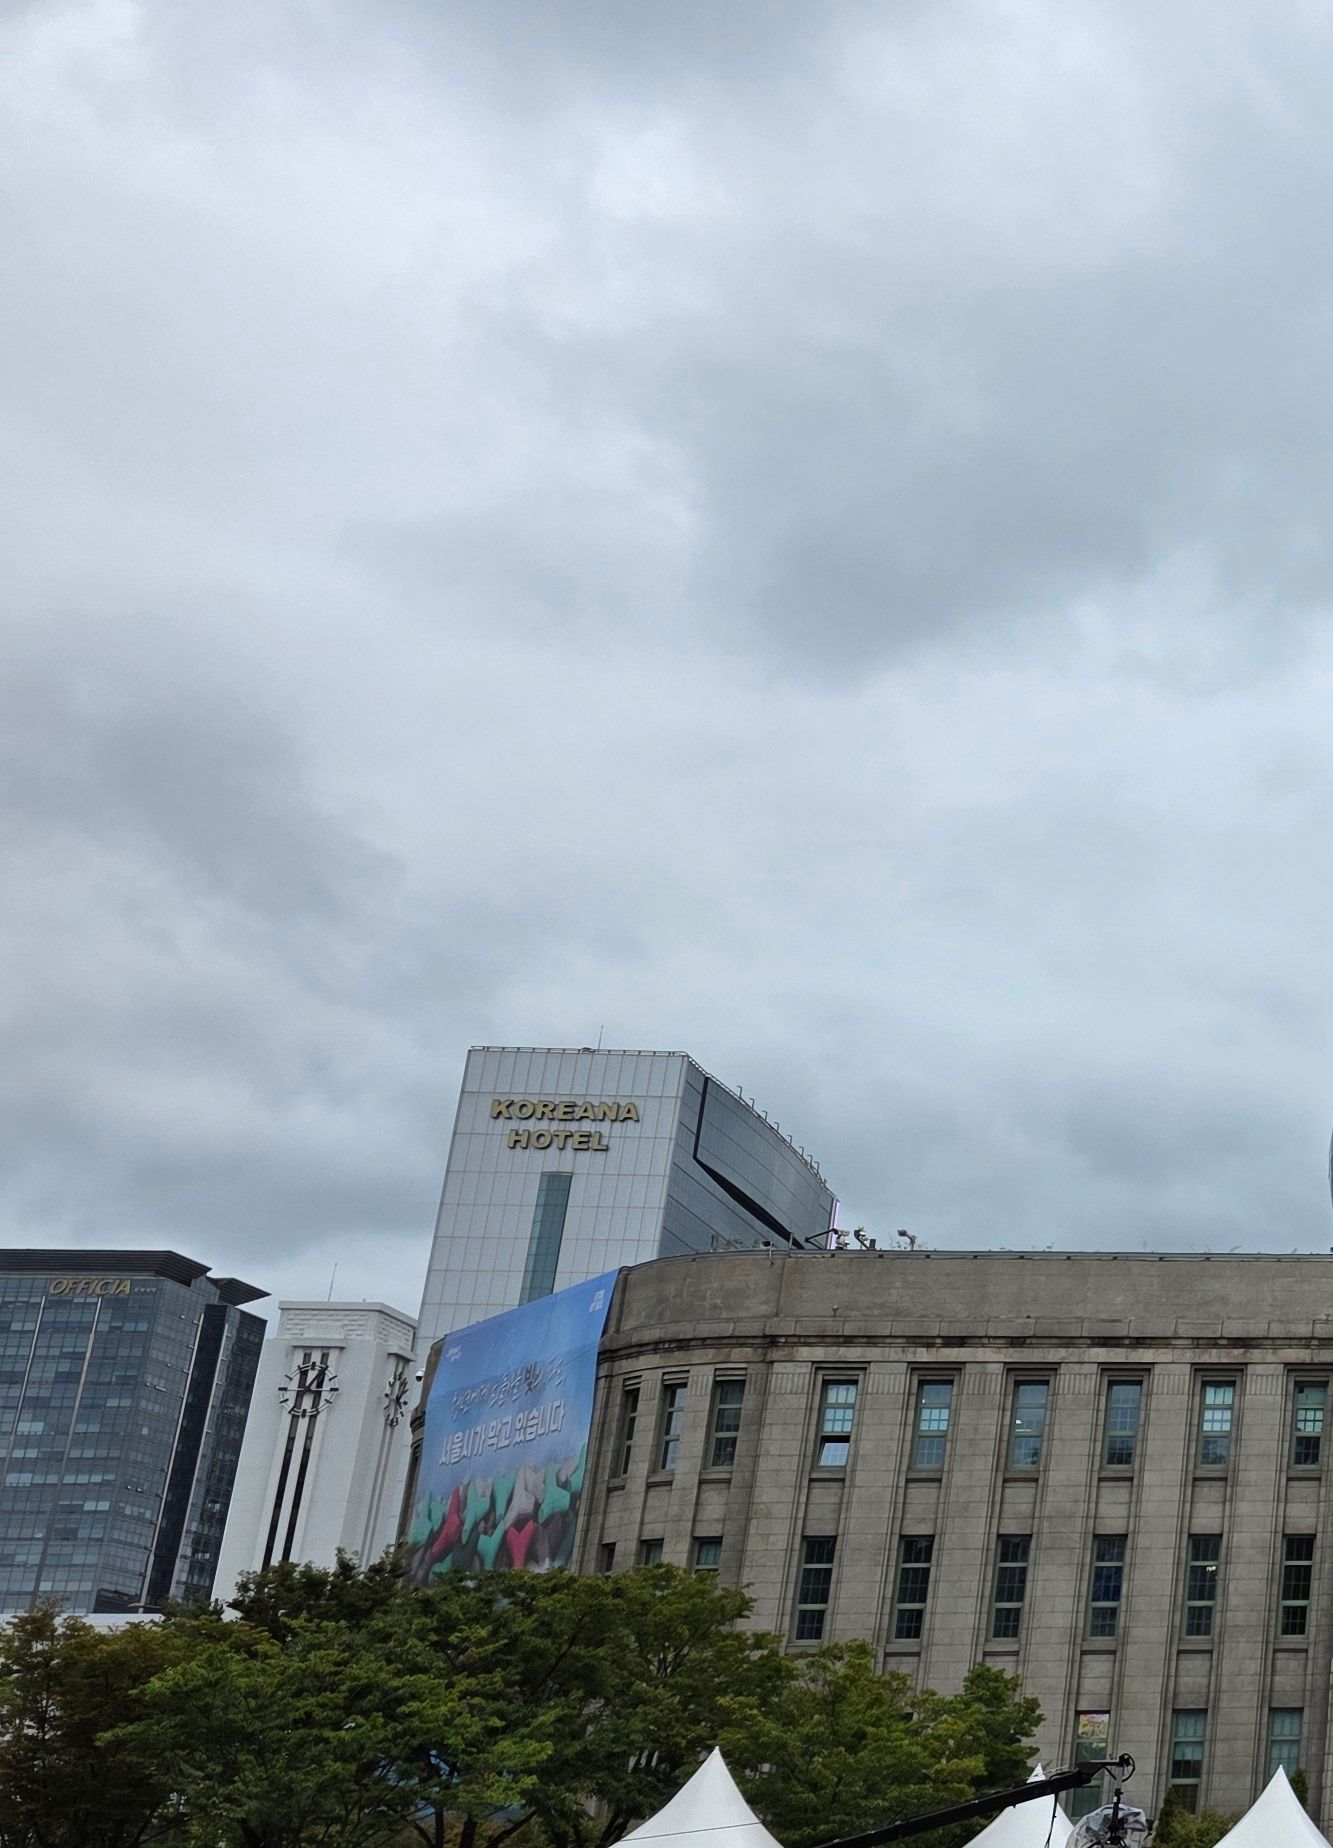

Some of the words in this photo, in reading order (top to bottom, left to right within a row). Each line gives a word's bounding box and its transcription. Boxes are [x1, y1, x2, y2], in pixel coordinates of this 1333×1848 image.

[490, 1099, 640, 1122] KOREANA
[507, 1129, 609, 1151] HOTEL
[440, 1424, 486, 1466] 서울시가
[513, 1399, 566, 1446] 있습니다
